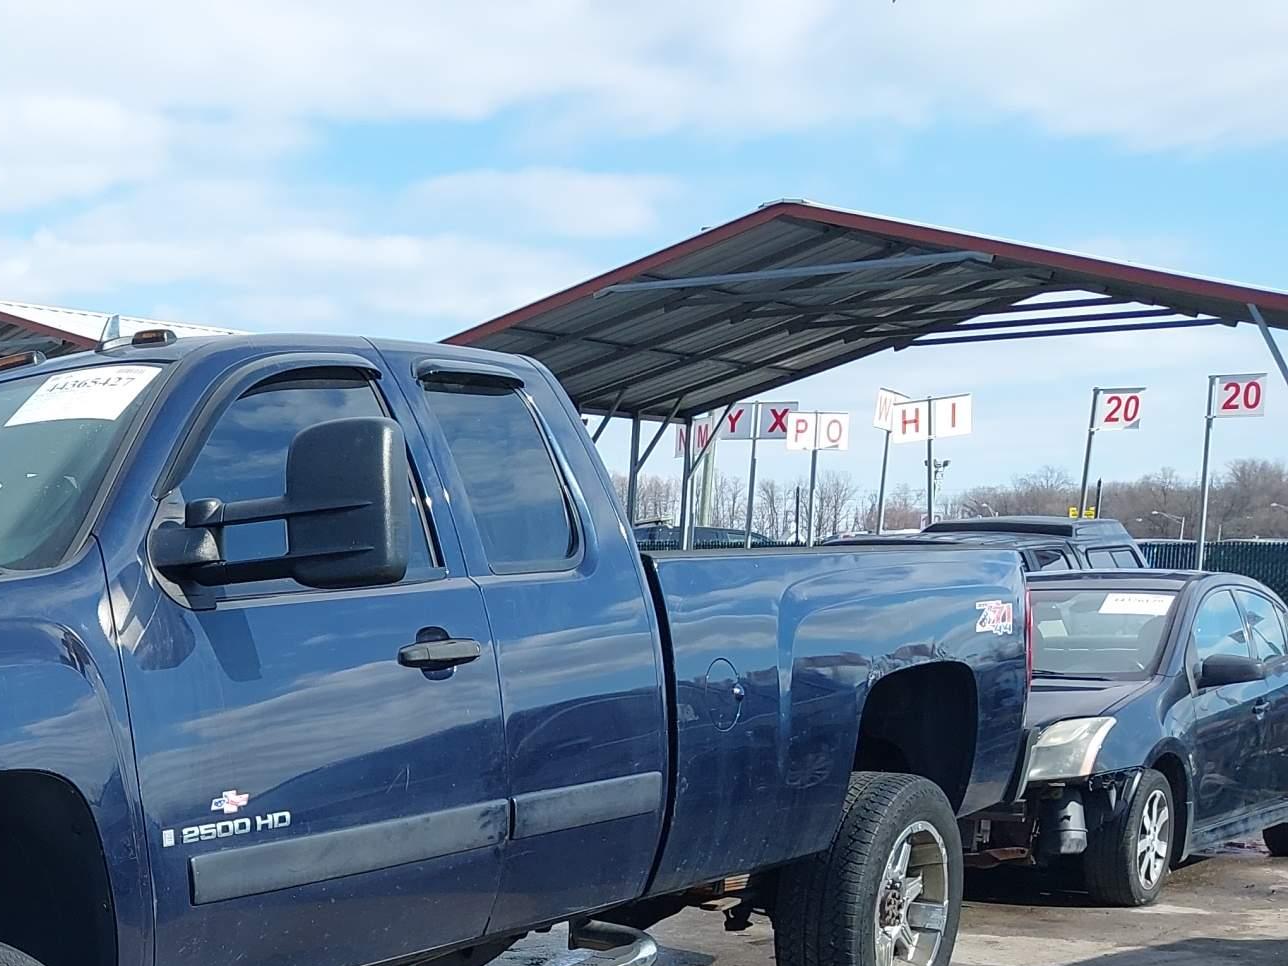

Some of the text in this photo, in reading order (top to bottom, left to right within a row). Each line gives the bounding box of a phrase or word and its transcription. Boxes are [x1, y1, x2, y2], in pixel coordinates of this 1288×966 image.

[1104, 395, 1140, 423] 20
[1221, 381, 1261, 410] 20
[728, 408, 789, 433] Y X
[795, 419, 808, 443] P
[901, 403, 956, 435] H I
[697, 423, 709, 449] M
[182, 811, 291, 845] 2500 HD
